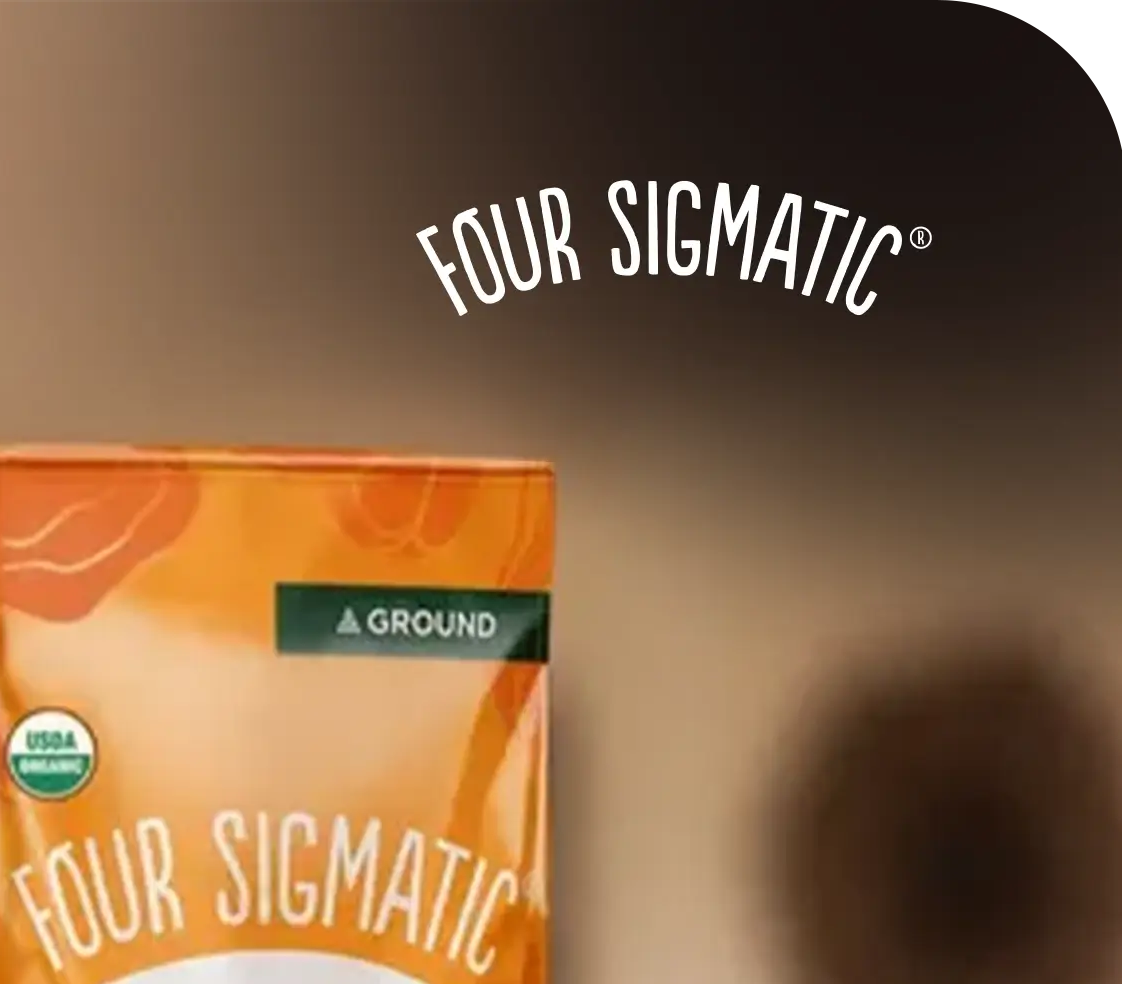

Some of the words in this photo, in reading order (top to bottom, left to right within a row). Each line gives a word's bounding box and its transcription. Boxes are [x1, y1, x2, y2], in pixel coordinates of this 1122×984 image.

[366, 608, 498, 639] GROUND
[25, 729, 78, 751] USDA
[11, 817, 185, 973] FOUR
[212, 810, 519, 976] SIGMATIC
